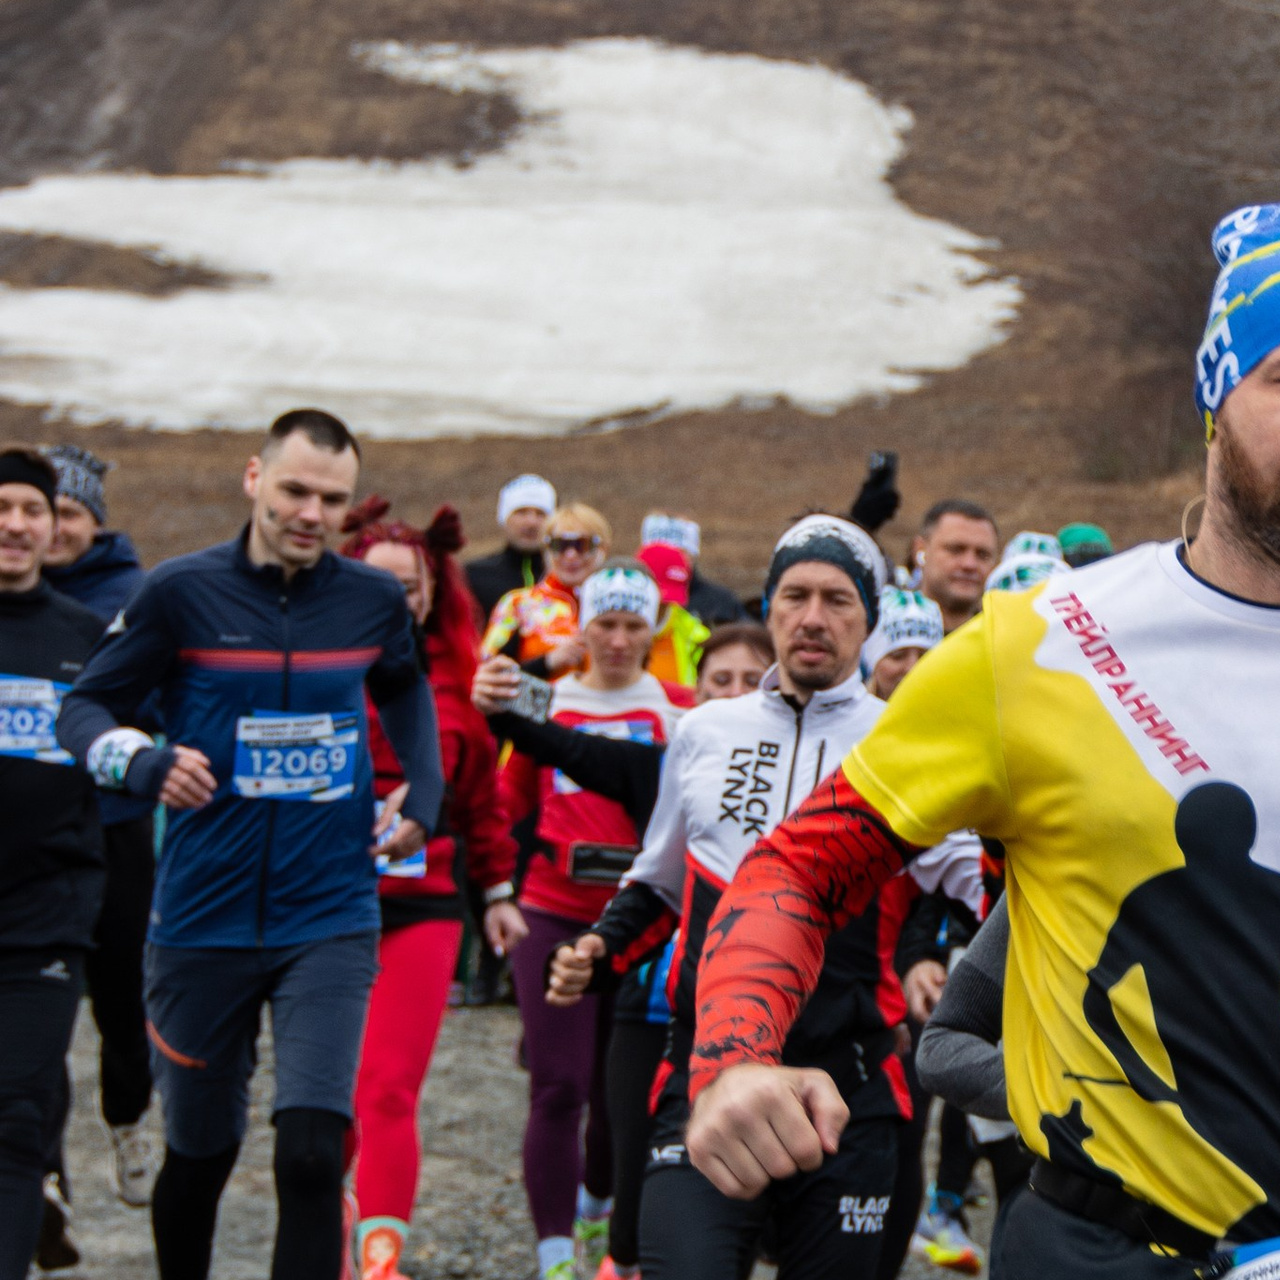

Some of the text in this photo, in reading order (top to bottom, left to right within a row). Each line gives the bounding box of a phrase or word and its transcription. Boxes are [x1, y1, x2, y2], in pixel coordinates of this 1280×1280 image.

[1050, 591, 1211, 777] ТРЕЙЛРАННИНГ
[251, 746, 347, 776] 12069
[719, 748, 753, 823] LYNX
[743, 741, 780, 837] BLACK
